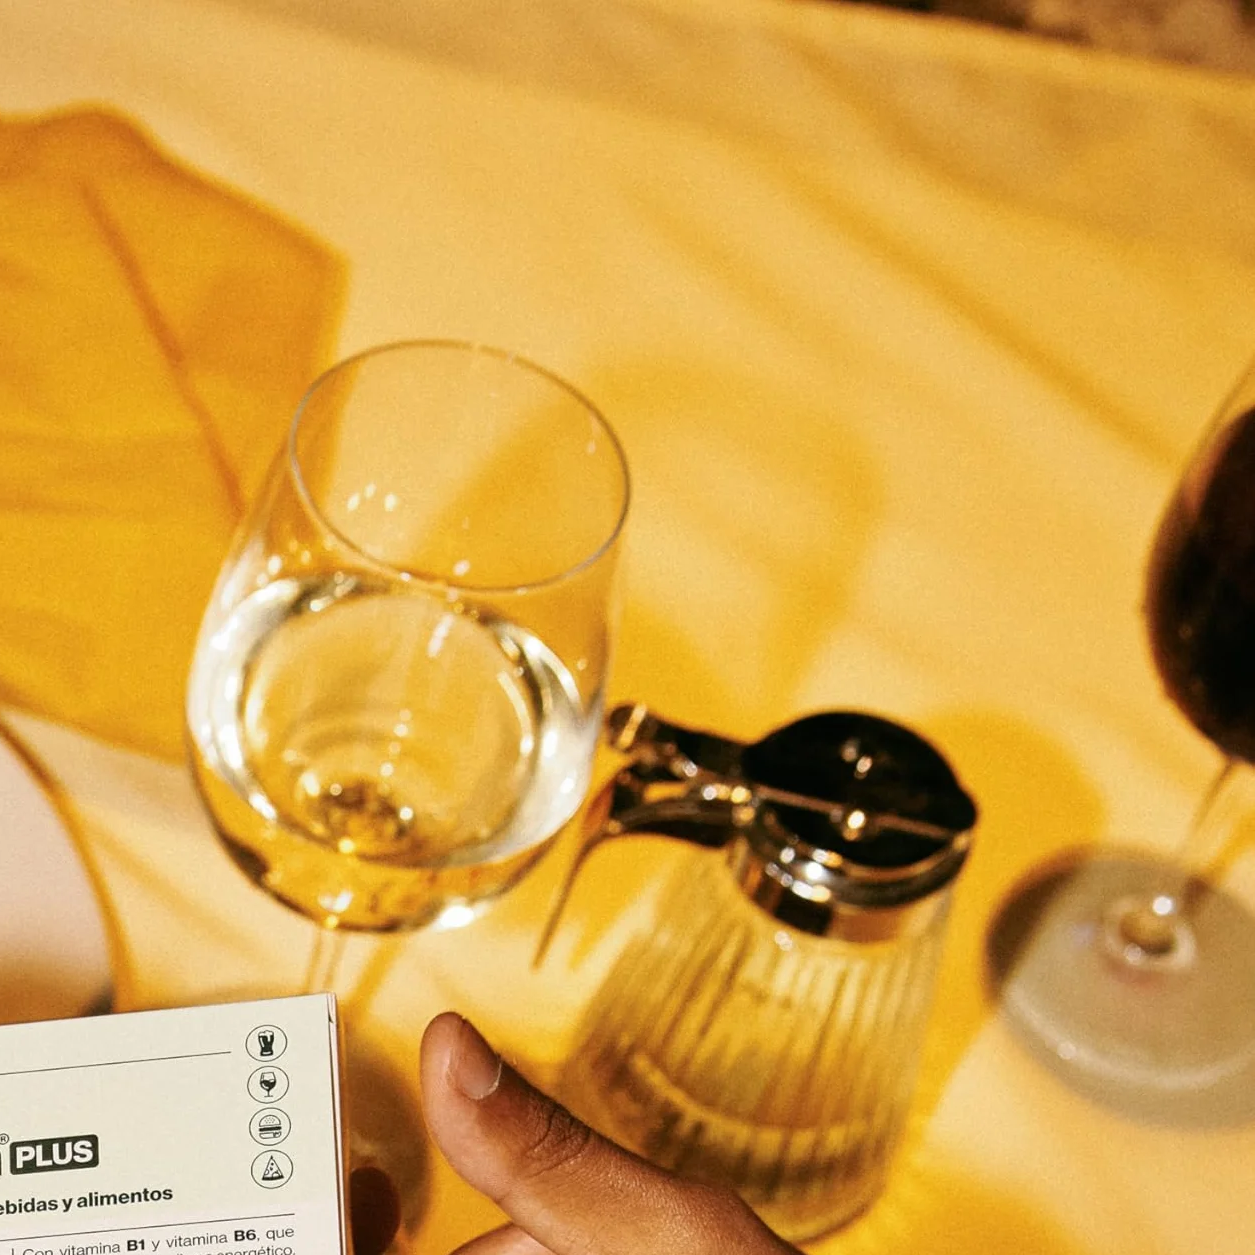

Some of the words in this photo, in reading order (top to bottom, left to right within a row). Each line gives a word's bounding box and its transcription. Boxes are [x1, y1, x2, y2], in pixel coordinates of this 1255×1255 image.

[15, 1140, 93, 1169] PLUS
[61, 1197, 74, 1213] y
[76, 1187, 174, 1209] alimentos
[126, 1238, 146, 1252] B1
[151, 1239, 161, 1253] y
[165, 1231, 229, 1249] vitamina
[233, 1228, 261, 1243] B6,
[265, 1227, 295, 1242] que
